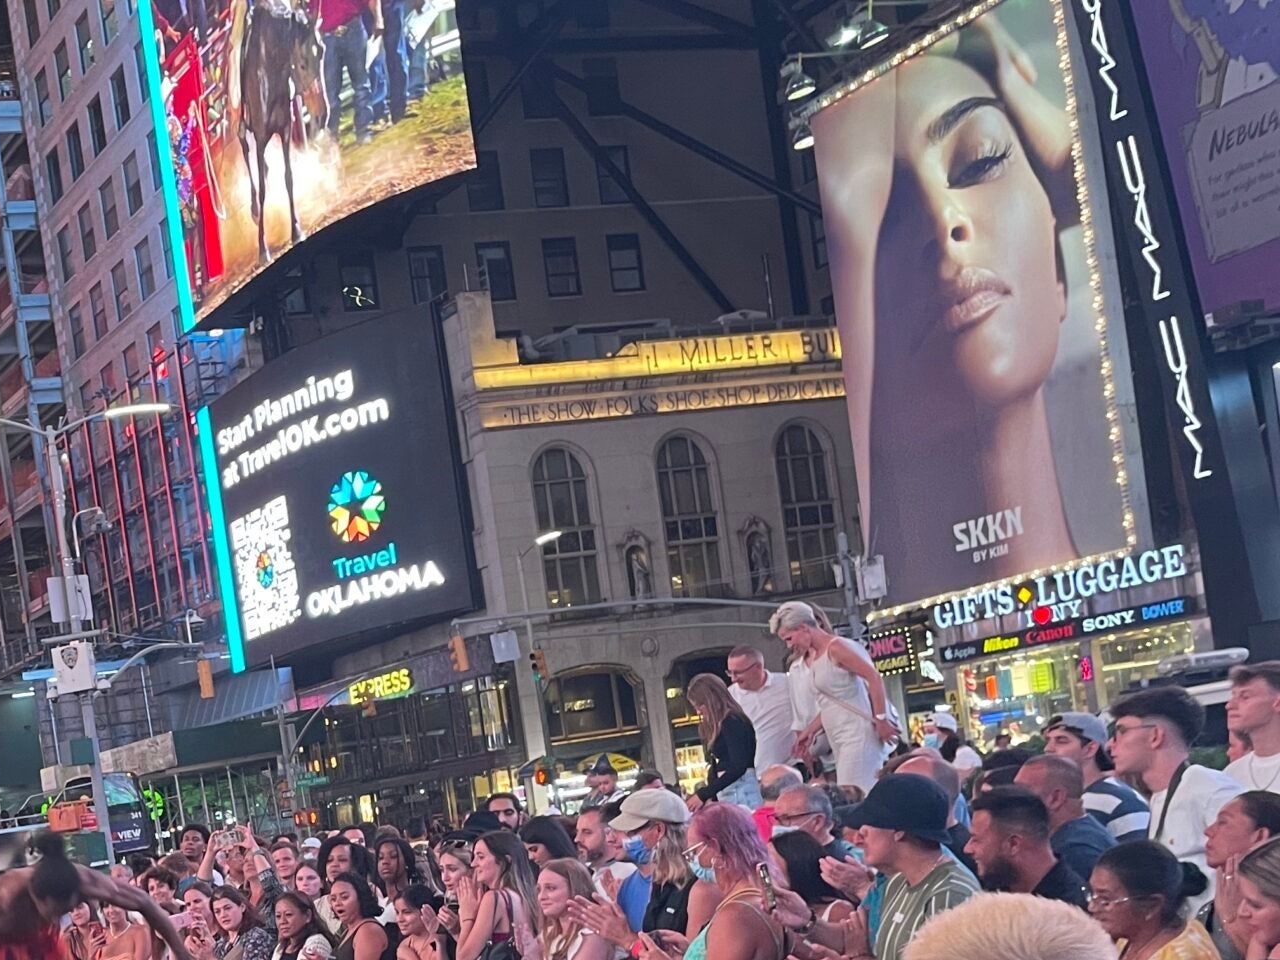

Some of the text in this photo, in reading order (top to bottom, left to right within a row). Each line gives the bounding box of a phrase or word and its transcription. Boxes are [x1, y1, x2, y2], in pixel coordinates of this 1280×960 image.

[679, 336, 779, 366] MILLER
[217, 369, 354, 454] Start Planning
[507, 406, 542, 424] THE
[548, 402, 596, 421] SHOW
[606, 397, 658, 415] FOLKS
[667, 391, 712, 410] SHOE
[717, 386, 760, 405] SHOP
[223, 398, 390, 489] at TravelOK.com
[953, 507, 1025, 552] SKKN
[332, 543, 396, 579] Travel
[973, 543, 1009, 563] BY KIM
[306, 560, 446, 618] OKLAHOMA
[934, 544, 1186, 629] GIFTS LUGGAGE
[953, 600, 1184, 660] Apple Nikon Canon SONY BOWER
[1025, 599, 1083, 628] I NY
